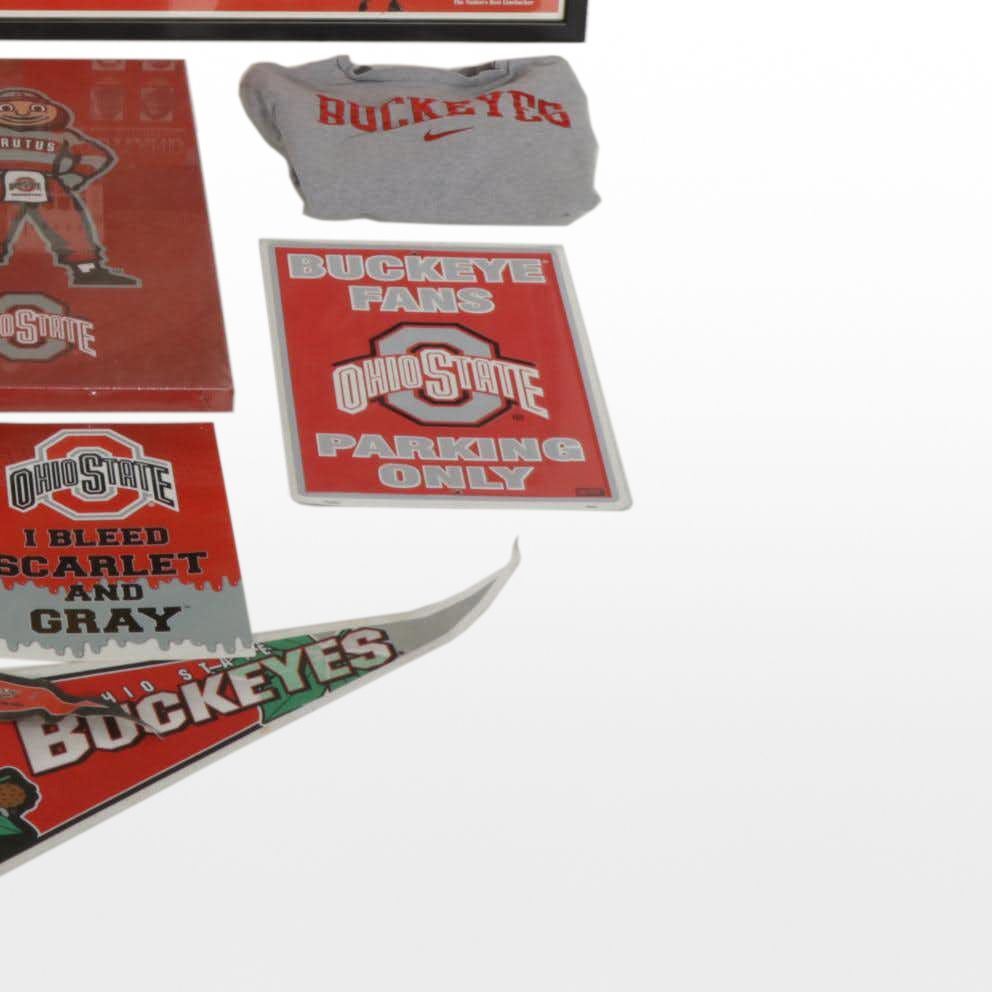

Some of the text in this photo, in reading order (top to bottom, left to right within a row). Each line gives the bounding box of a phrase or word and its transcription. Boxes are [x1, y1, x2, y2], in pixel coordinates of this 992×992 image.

[315, 89, 572, 132] BUCKEYES
[286, 253, 548, 284] BUCKEYE
[347, 285, 496, 314] FANS
[14, 308, 98, 359] STATE
[332, 348, 550, 420] OHIO STATE
[315, 432, 586, 463] PARKING
[9, 452, 176, 510] OHIO STATE
[377, 463, 535, 491] ONLY
[23, 527, 169, 547] I BLEED
[64, 583, 144, 602] AND
[29, 606, 182, 635] GRAY
[15, 626, 398, 775] BUCKEYES
